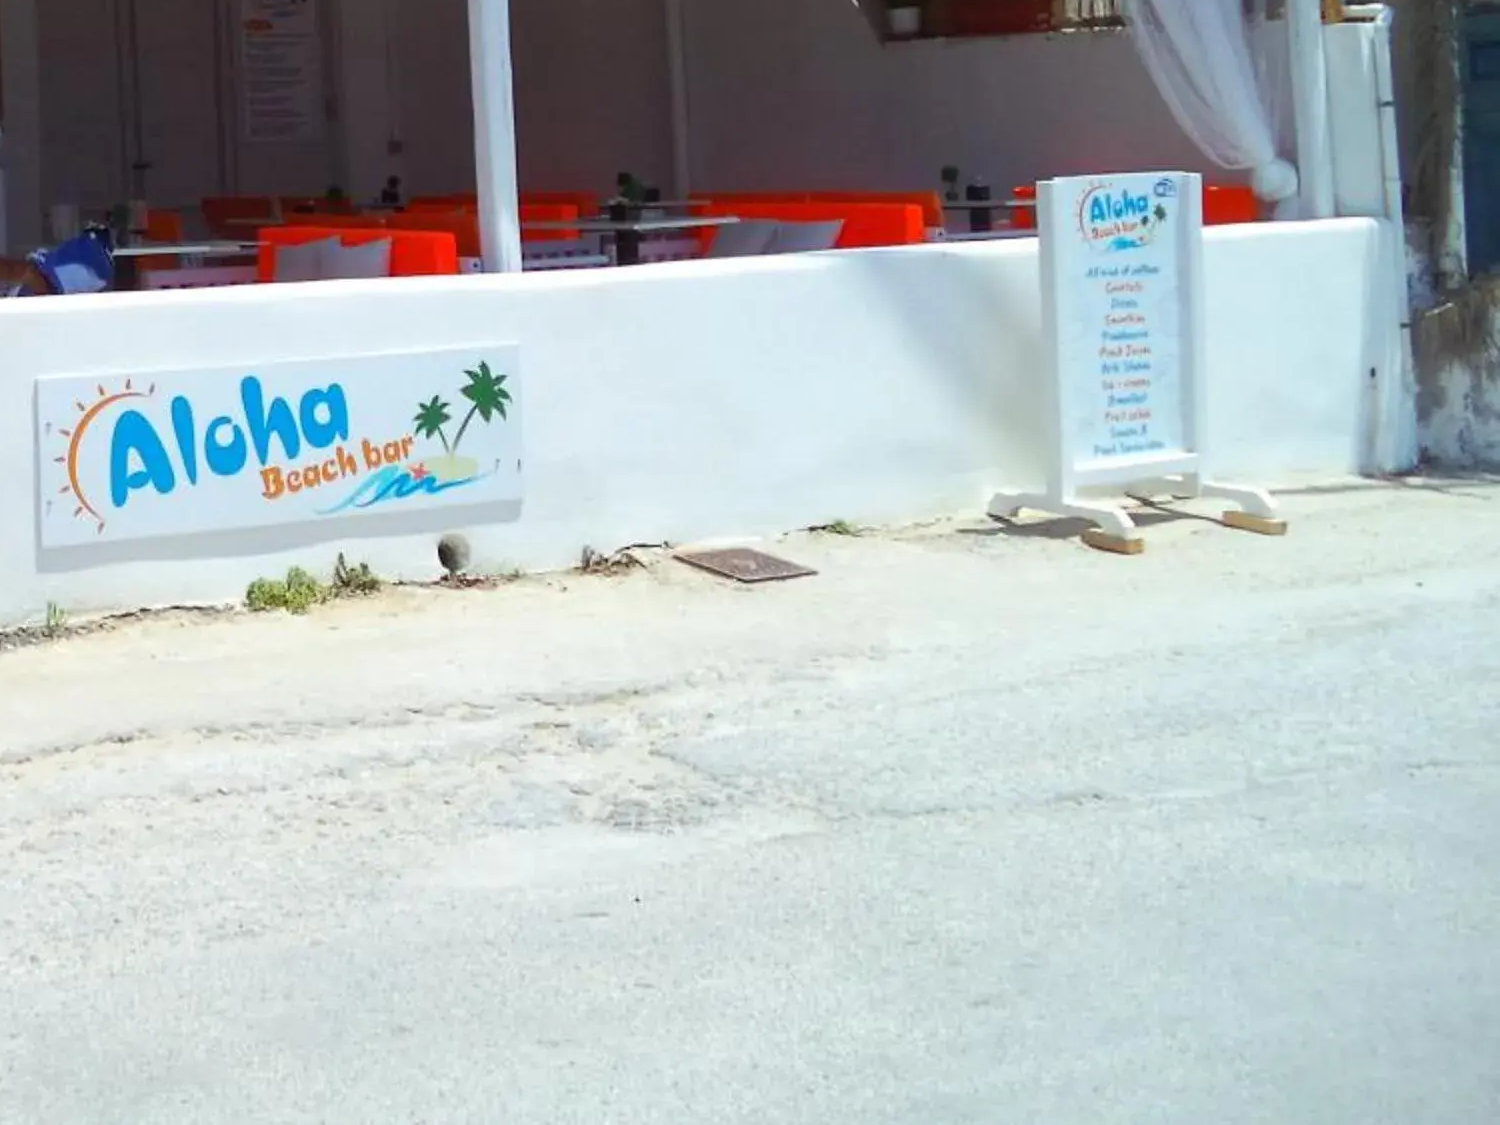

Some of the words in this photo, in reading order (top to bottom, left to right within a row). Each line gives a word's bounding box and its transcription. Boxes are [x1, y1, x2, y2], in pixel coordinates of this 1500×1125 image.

[1090, 189, 1149, 223] Aloha
[110, 375, 349, 508] Aloha
[260, 445, 358, 500] Beach
[362, 434, 415, 469] bar
